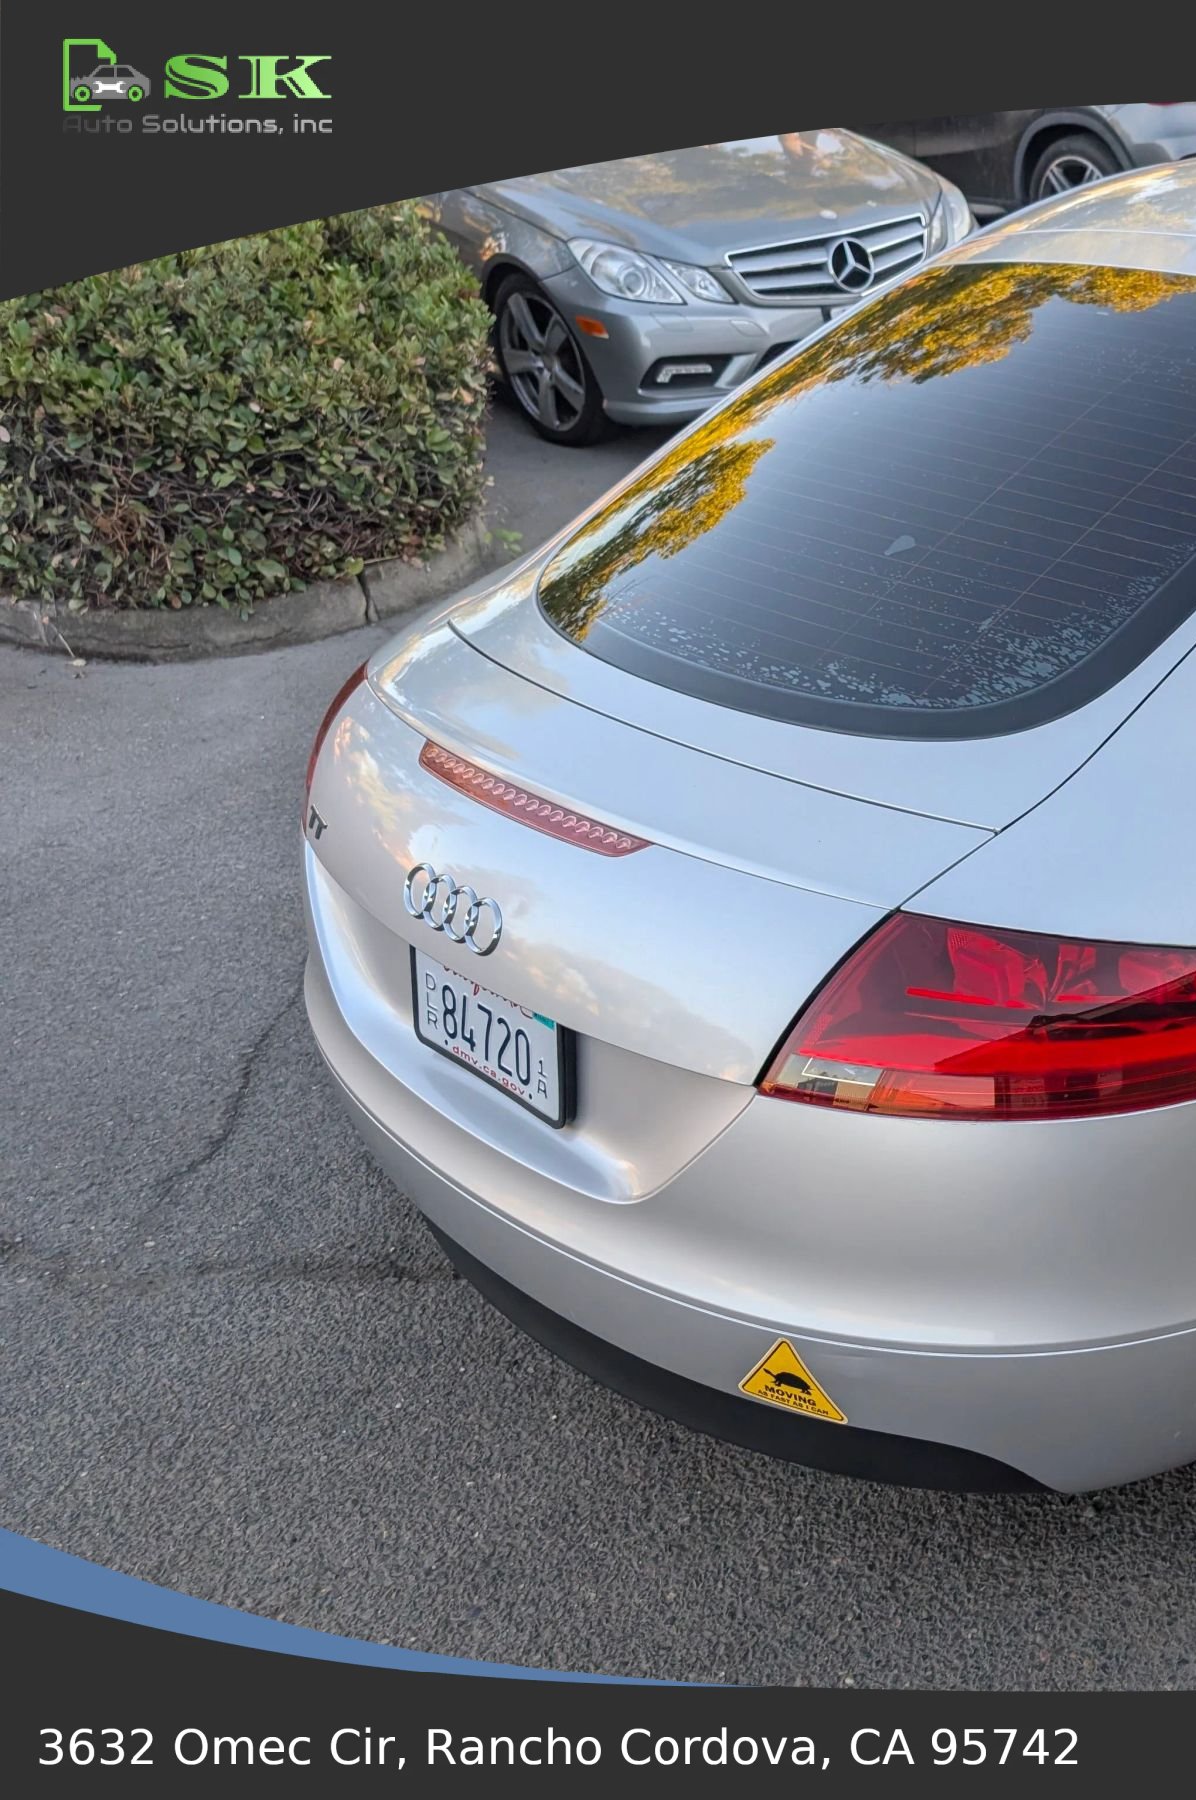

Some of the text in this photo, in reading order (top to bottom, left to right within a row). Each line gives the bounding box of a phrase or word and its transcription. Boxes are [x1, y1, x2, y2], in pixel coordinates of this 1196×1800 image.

[309, 804, 328, 840] TT
[441, 984, 531, 1086] 84720
[452, 1045, 525, 1096] dmv.ca.gov
[757, 1389, 769, 1397] AS
[770, 1392, 791, 1405] FAST
[792, 1400, 804, 1408] AS
[810, 1405, 829, 1415] CAN
[764, 1384, 817, 1406] MOVING
